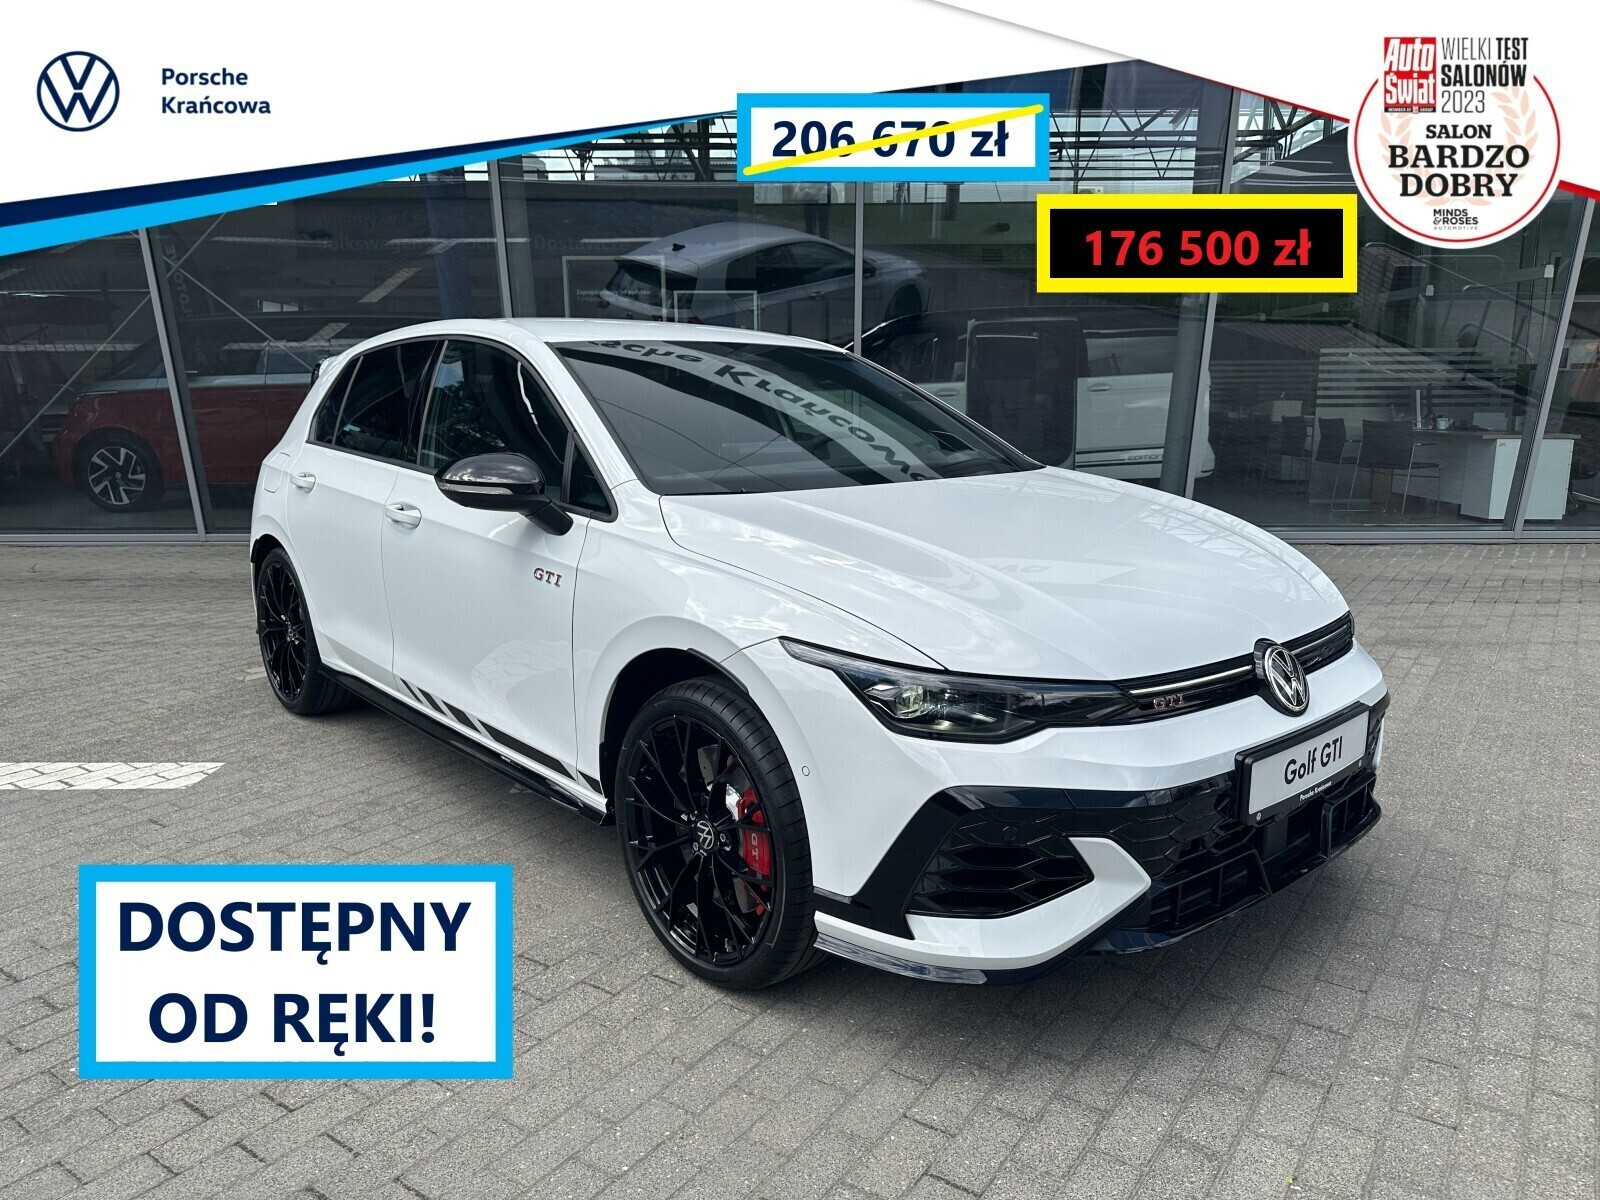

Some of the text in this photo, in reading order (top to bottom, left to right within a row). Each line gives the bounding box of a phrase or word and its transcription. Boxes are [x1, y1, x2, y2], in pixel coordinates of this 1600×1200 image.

[533, 567, 562, 587] GTI
[1153, 693, 1184, 709] GTI
[1284, 735, 1343, 785] Golf GTI
[751, 832, 759, 870] GTI
